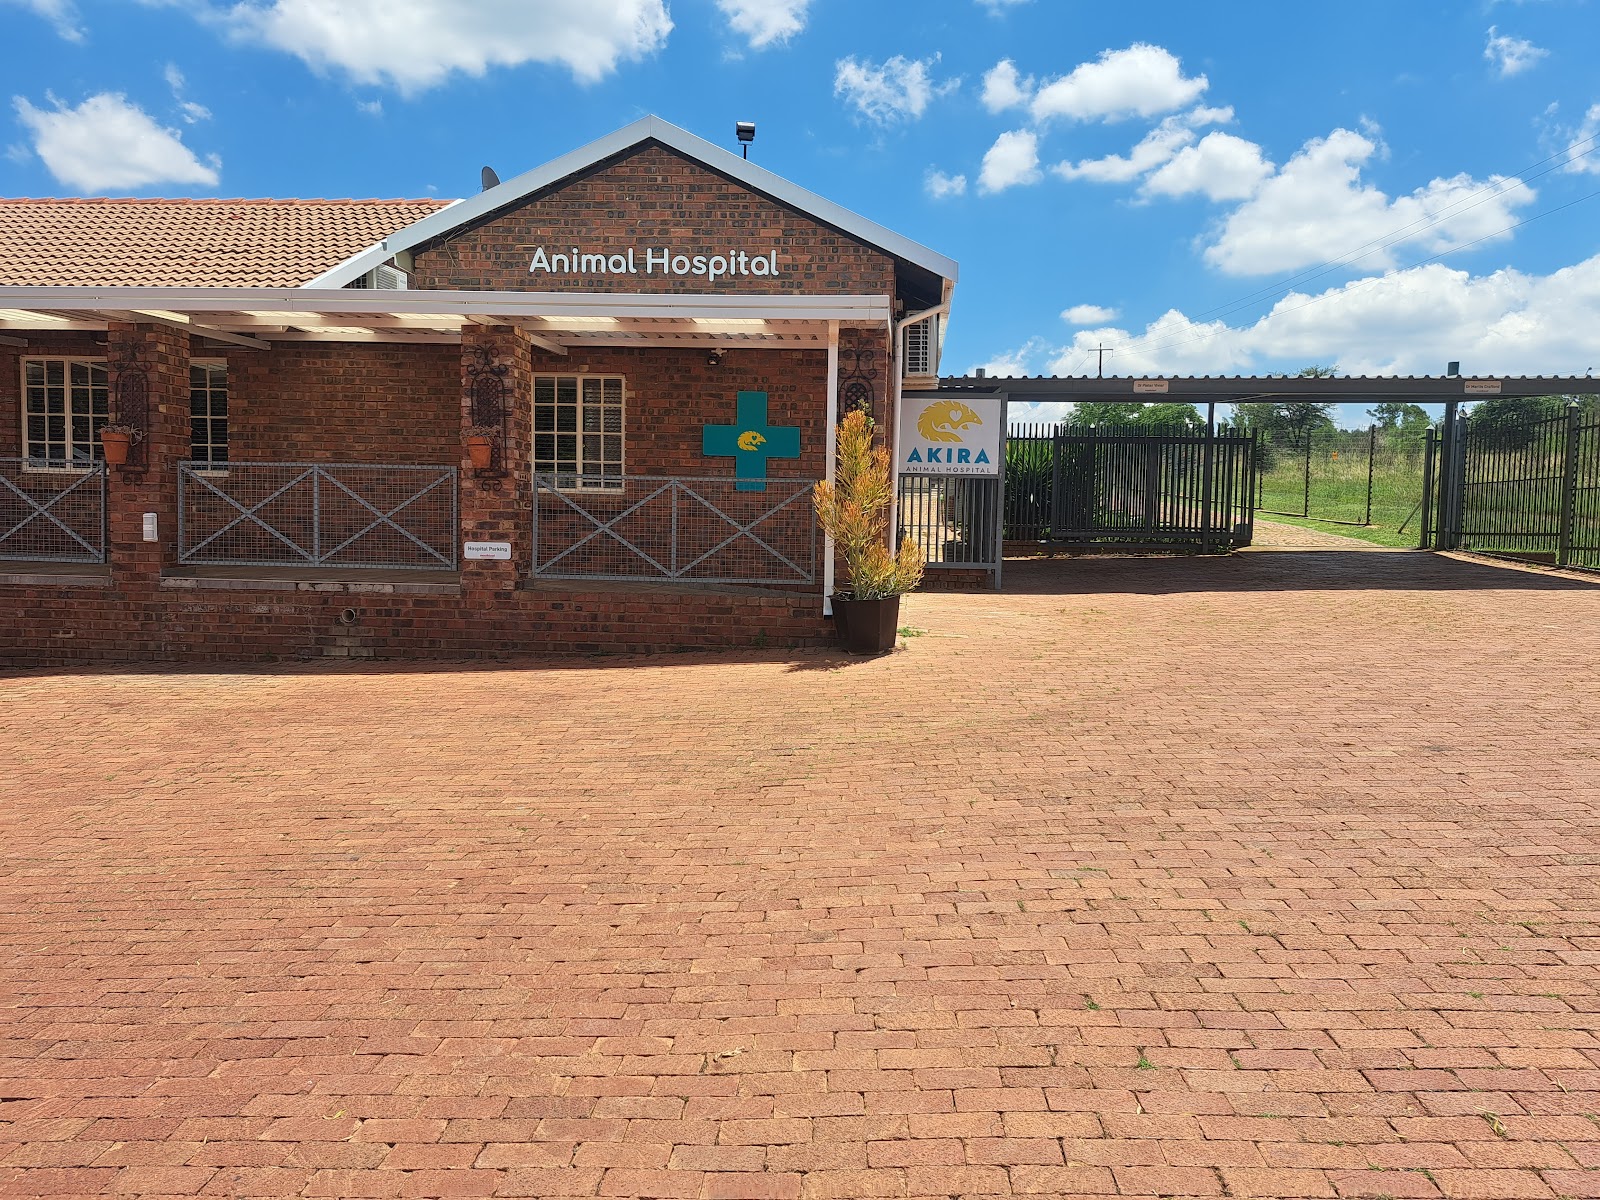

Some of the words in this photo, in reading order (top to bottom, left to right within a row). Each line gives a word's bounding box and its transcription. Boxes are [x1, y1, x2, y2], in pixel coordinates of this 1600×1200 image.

[528, 246, 638, 274] Animal
[646, 247, 780, 282] Hospital
[906, 447, 991, 464] AKIRA
